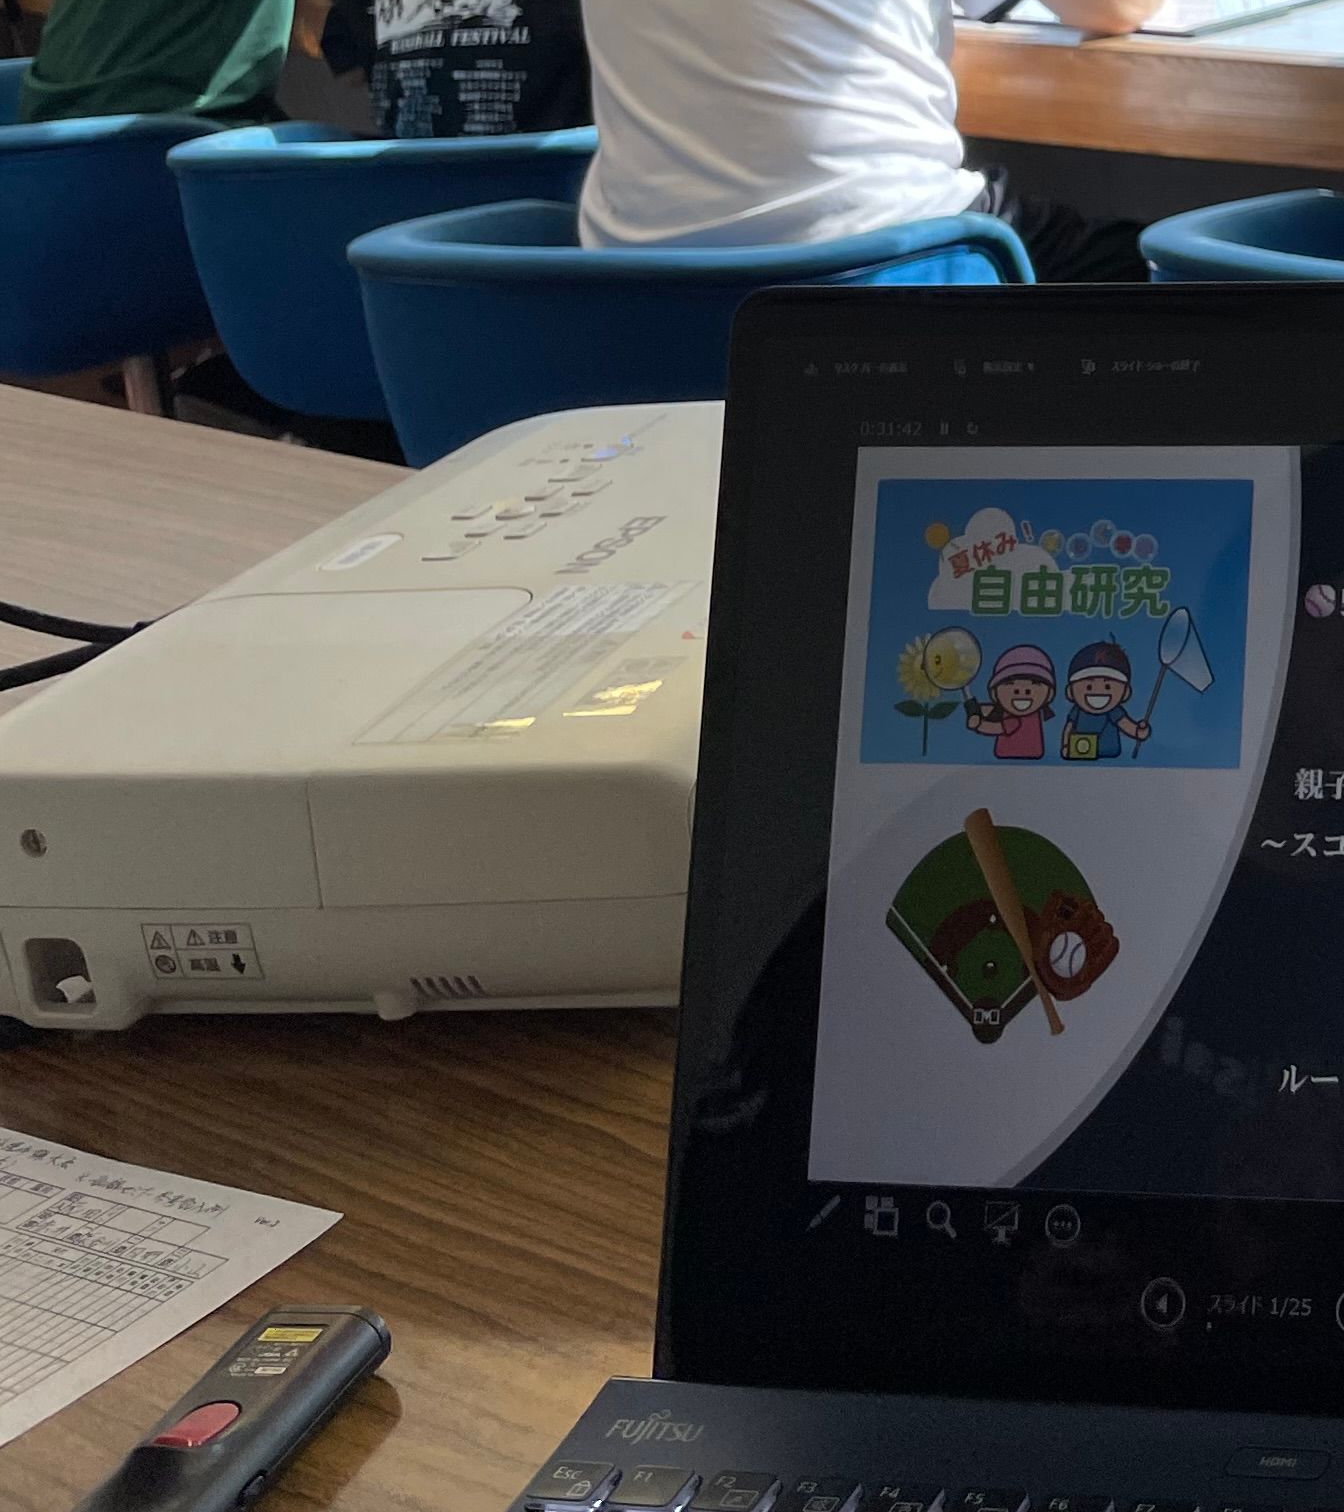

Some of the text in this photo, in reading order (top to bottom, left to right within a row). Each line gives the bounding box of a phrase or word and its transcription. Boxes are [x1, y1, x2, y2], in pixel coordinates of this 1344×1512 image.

[555, 516, 668, 575] EPSON
[971, 564, 1170, 619] 自由研究
[1270, 1296, 1312, 1318] 1/25
[607, 1409, 702, 1445] FUJITSU
[552, 1467, 582, 1481] Esc
[634, 1471, 654, 1484] F1
[716, 1476, 736, 1490] F2
[798, 1483, 817, 1494] F3
[880, 1487, 900, 1499] F4
[965, 1493, 984, 1505] F5
[1048, 1498, 1068, 1510] F6
